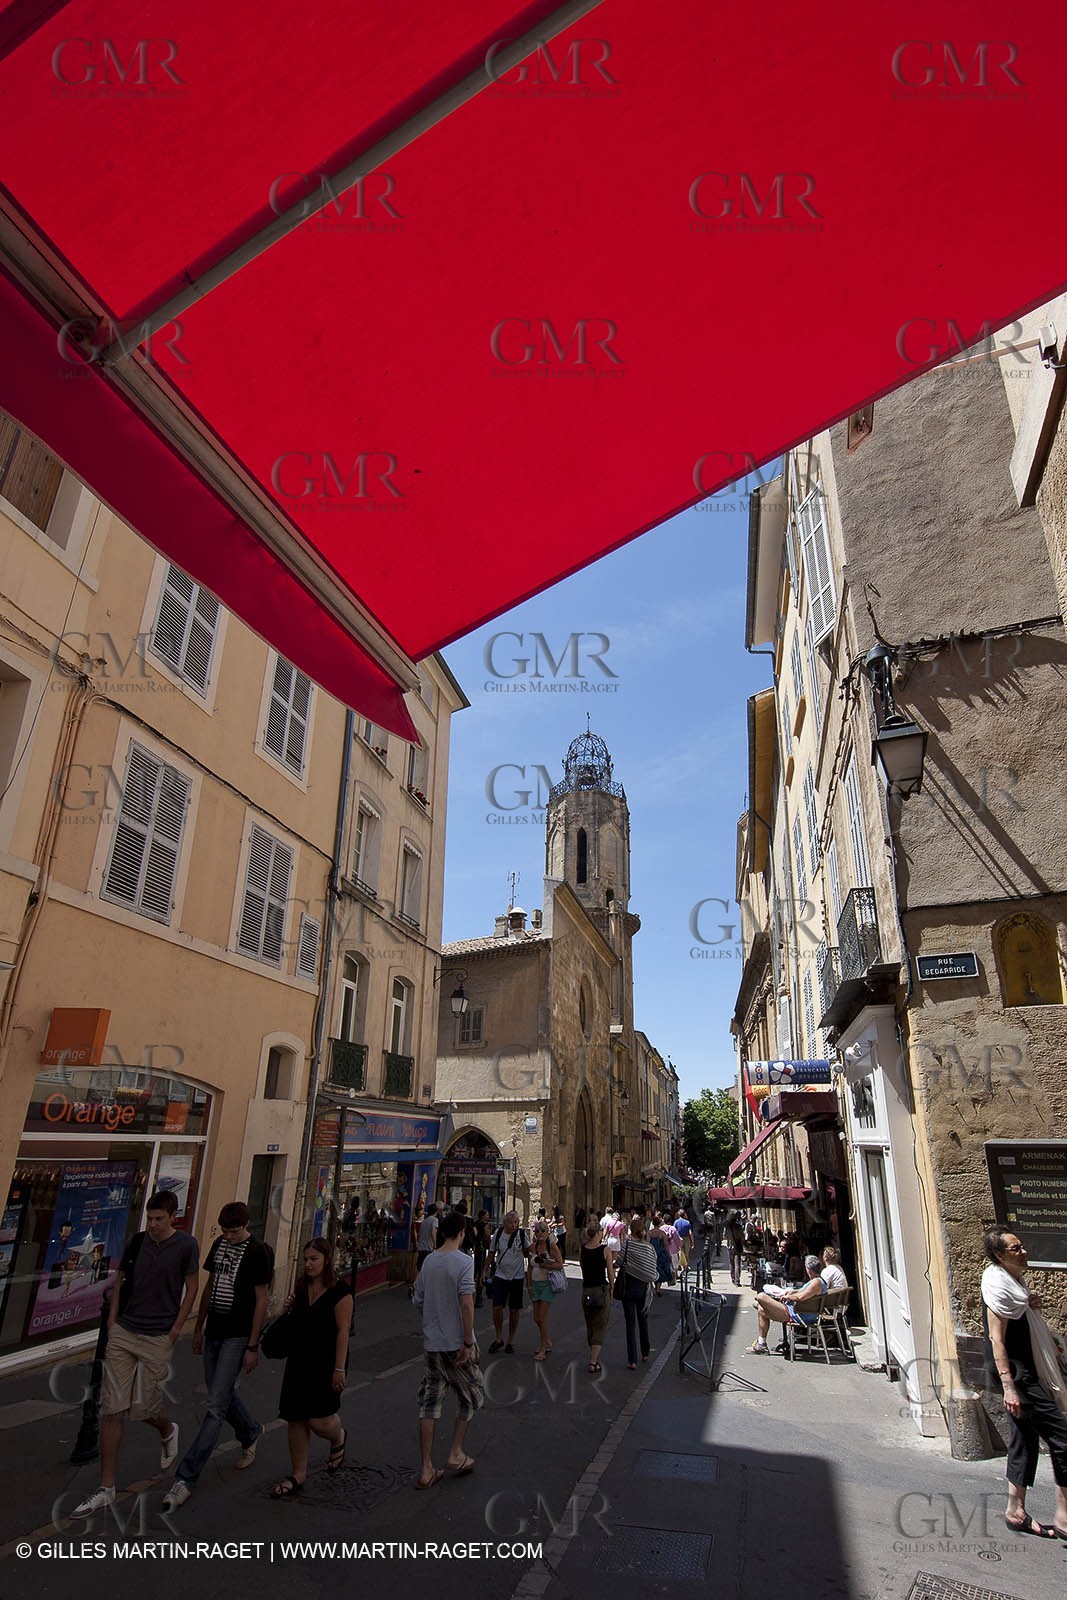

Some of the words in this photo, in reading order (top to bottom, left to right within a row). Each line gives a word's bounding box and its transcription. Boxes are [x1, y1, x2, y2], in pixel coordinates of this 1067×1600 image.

[46, 1050, 86, 1062] orange
[44, 1093, 136, 1130] Orange
[33, 1306, 81, 1328] orange.fr
